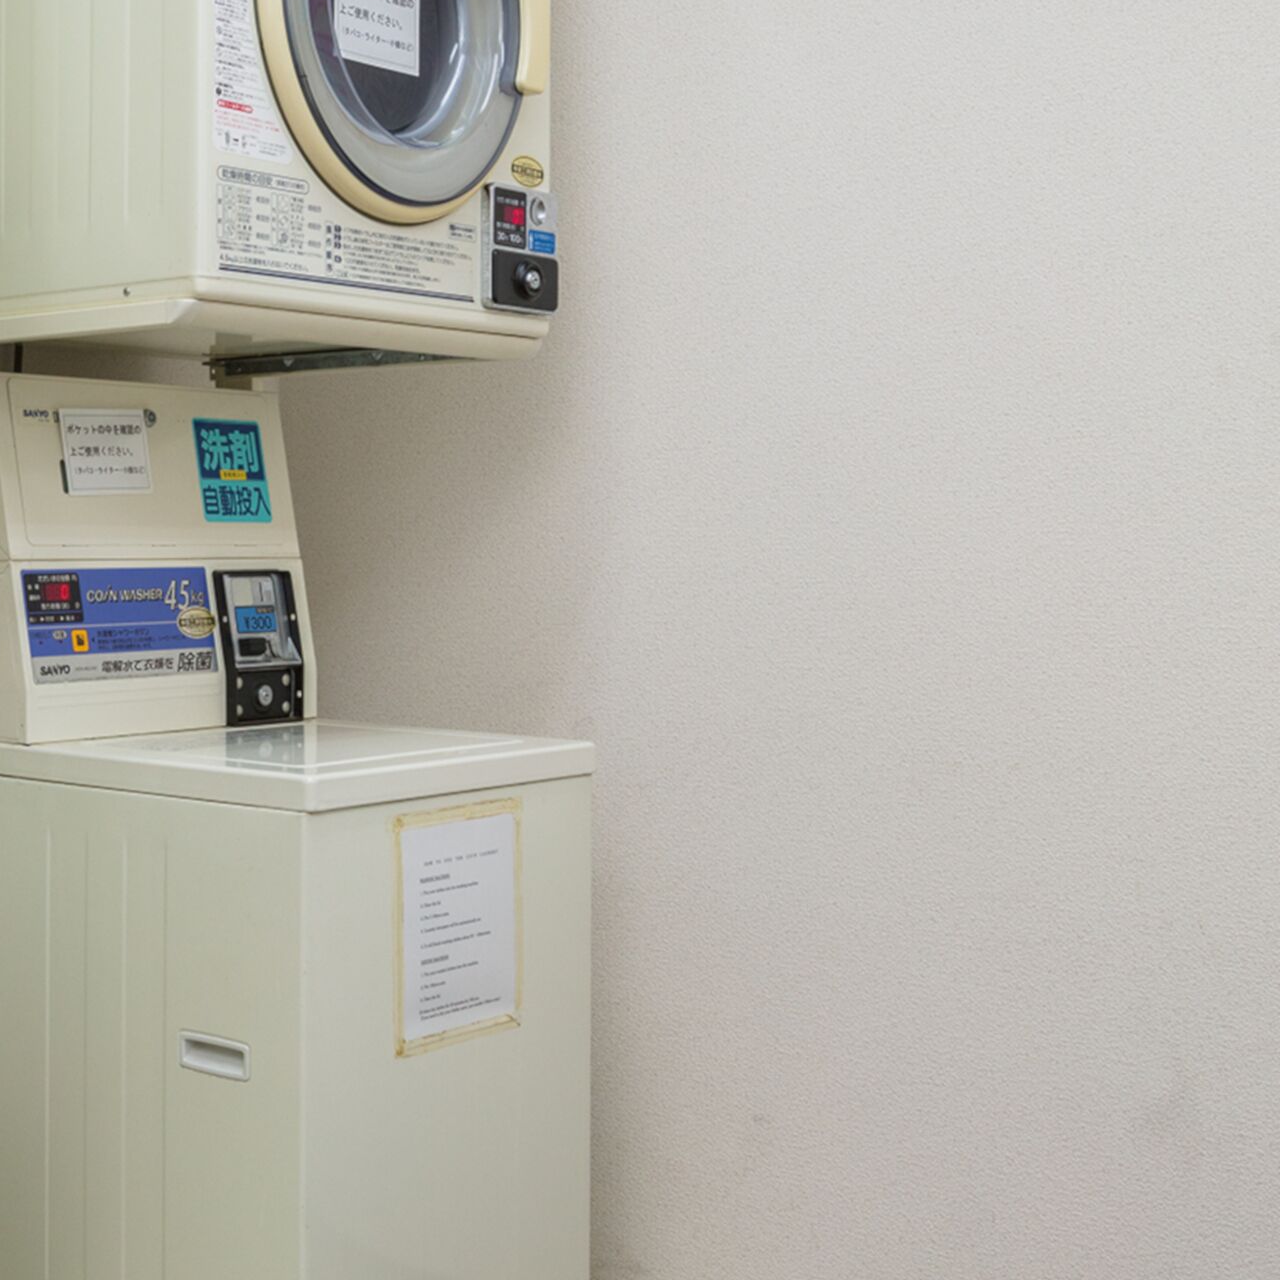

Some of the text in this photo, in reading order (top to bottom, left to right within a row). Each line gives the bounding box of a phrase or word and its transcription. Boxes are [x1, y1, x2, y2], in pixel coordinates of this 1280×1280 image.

[23, 409, 49, 418] SANYO
[200, 428, 260, 473] 洗剤
[203, 485, 271, 516] 自動投入
[121, 588, 163, 603] WASHER
[40, 664, 70, 676] SANYO
[177, 651, 212, 672] 除菌
